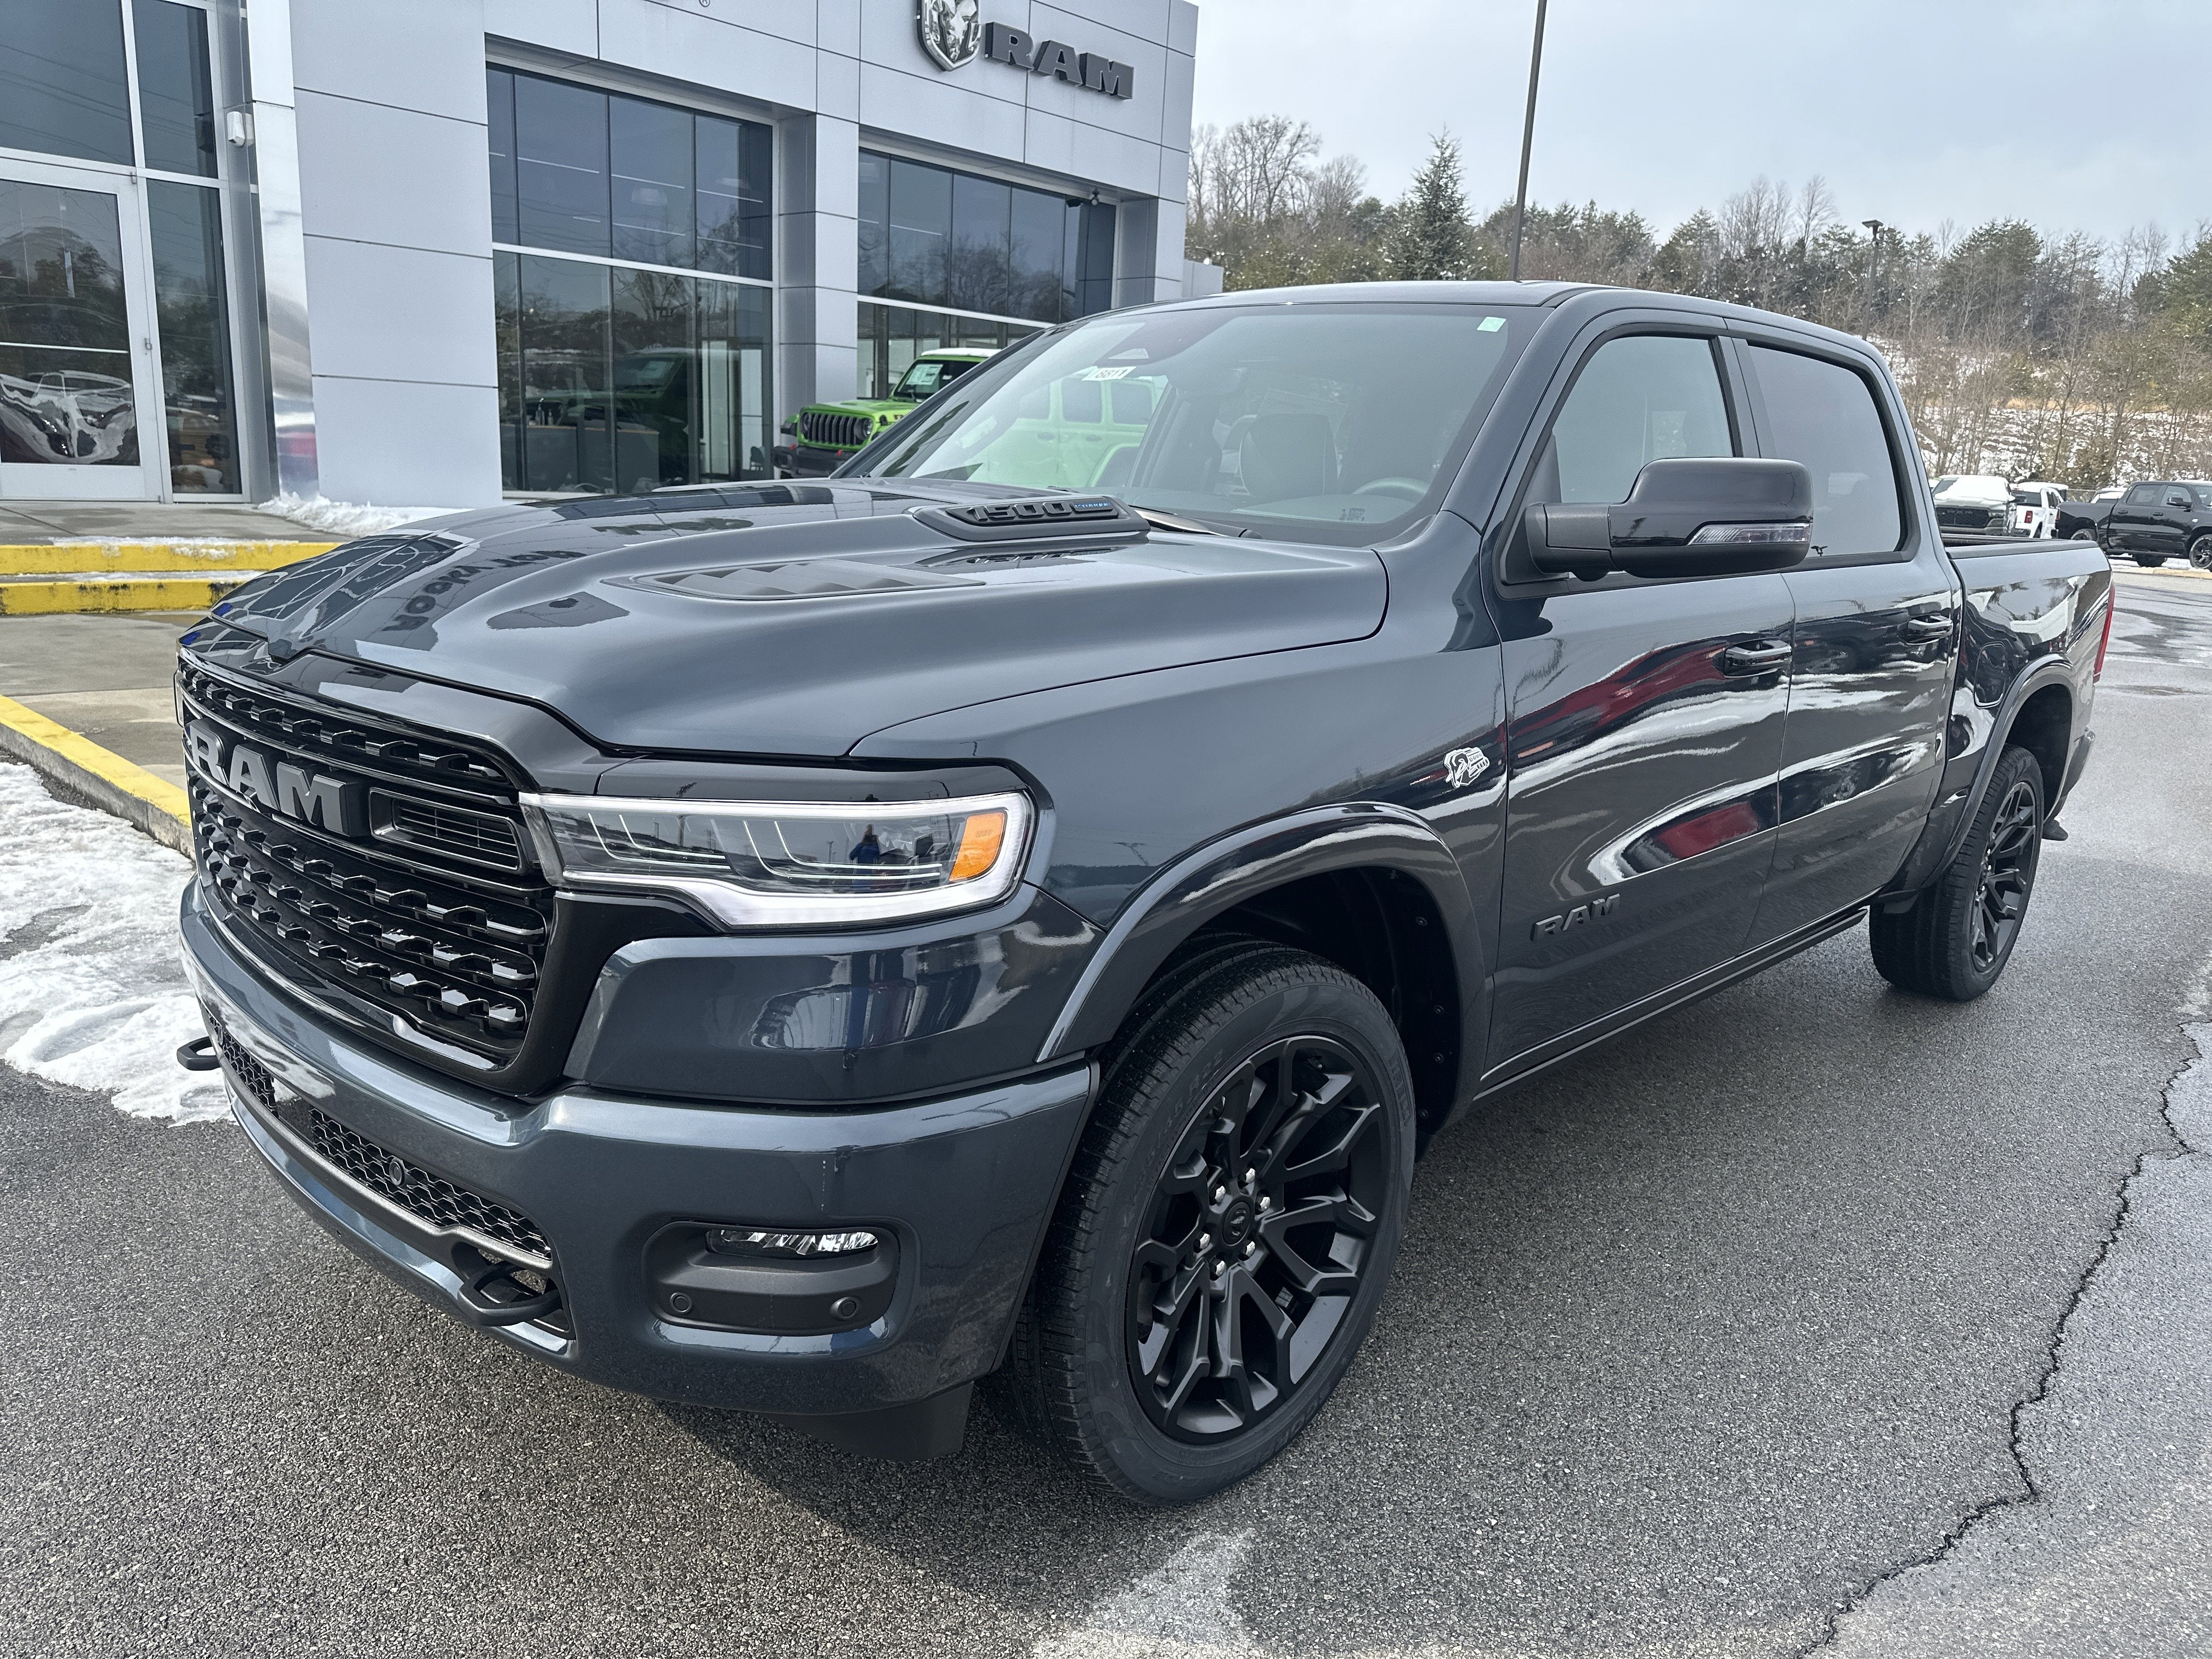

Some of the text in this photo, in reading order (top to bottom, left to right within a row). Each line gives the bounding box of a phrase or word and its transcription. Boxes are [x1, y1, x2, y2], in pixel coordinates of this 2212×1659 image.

[985, 21, 1134, 99] RAM
[1095, 369, 1128, 379] 8811
[966, 502, 1072, 521] 1500
[189, 718, 357, 837] RAM
[1531, 893, 1620, 942] RAM
